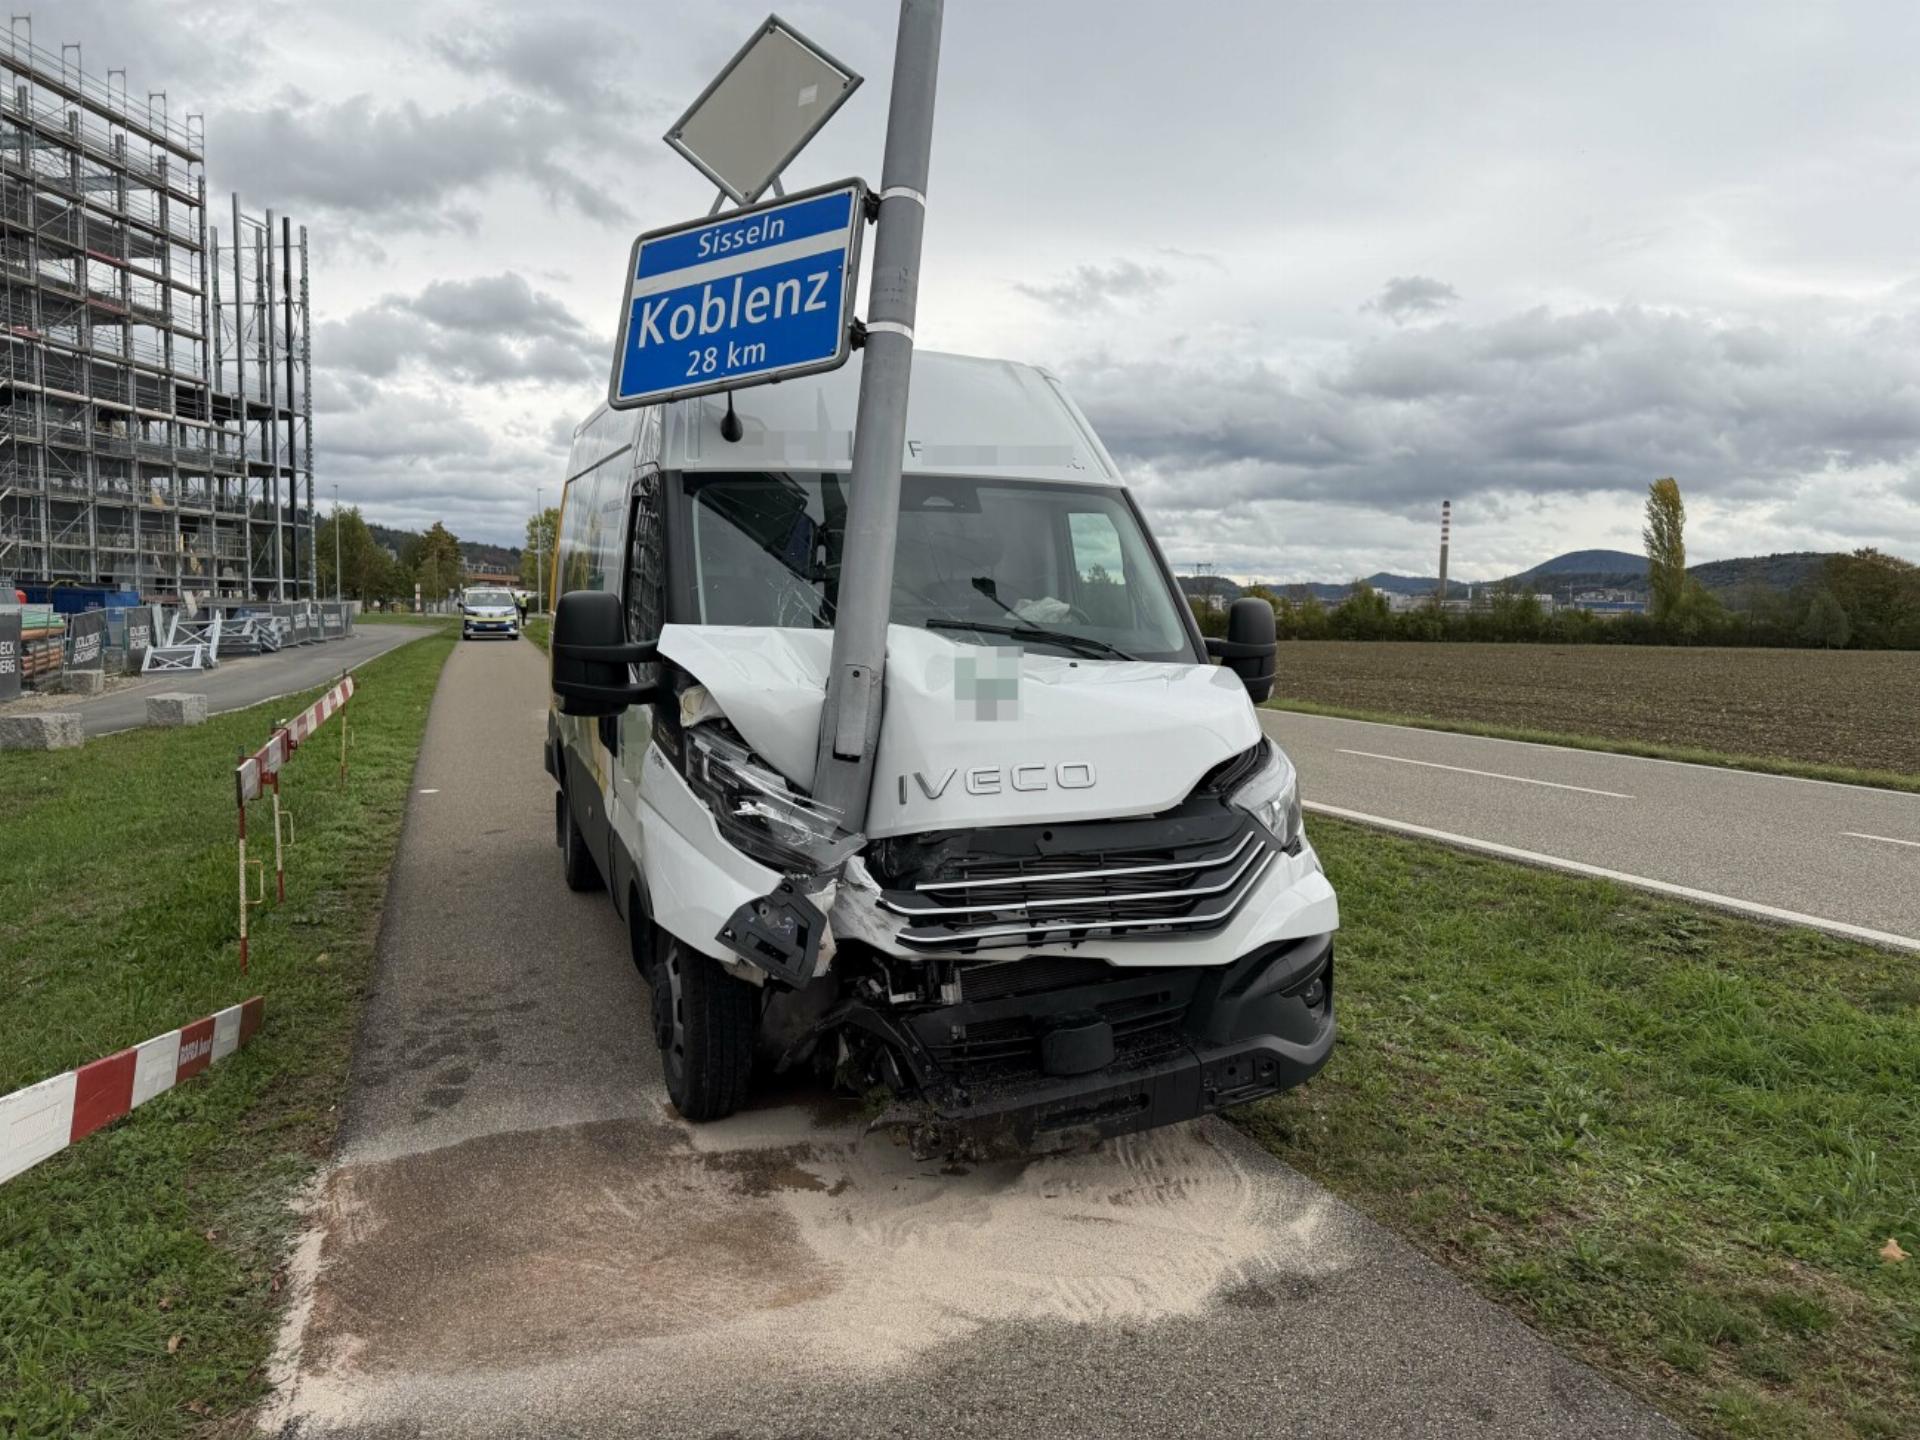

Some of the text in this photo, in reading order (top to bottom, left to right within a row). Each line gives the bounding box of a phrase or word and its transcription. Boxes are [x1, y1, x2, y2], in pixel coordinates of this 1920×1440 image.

[697, 215, 785, 258] Sisseln
[638, 271, 829, 349] Koblenz
[686, 341, 766, 377] 28 km
[0, 640, 15, 655] ECK
[0, 659, 15, 674] ERG
[898, 760, 1097, 806] IVECO
